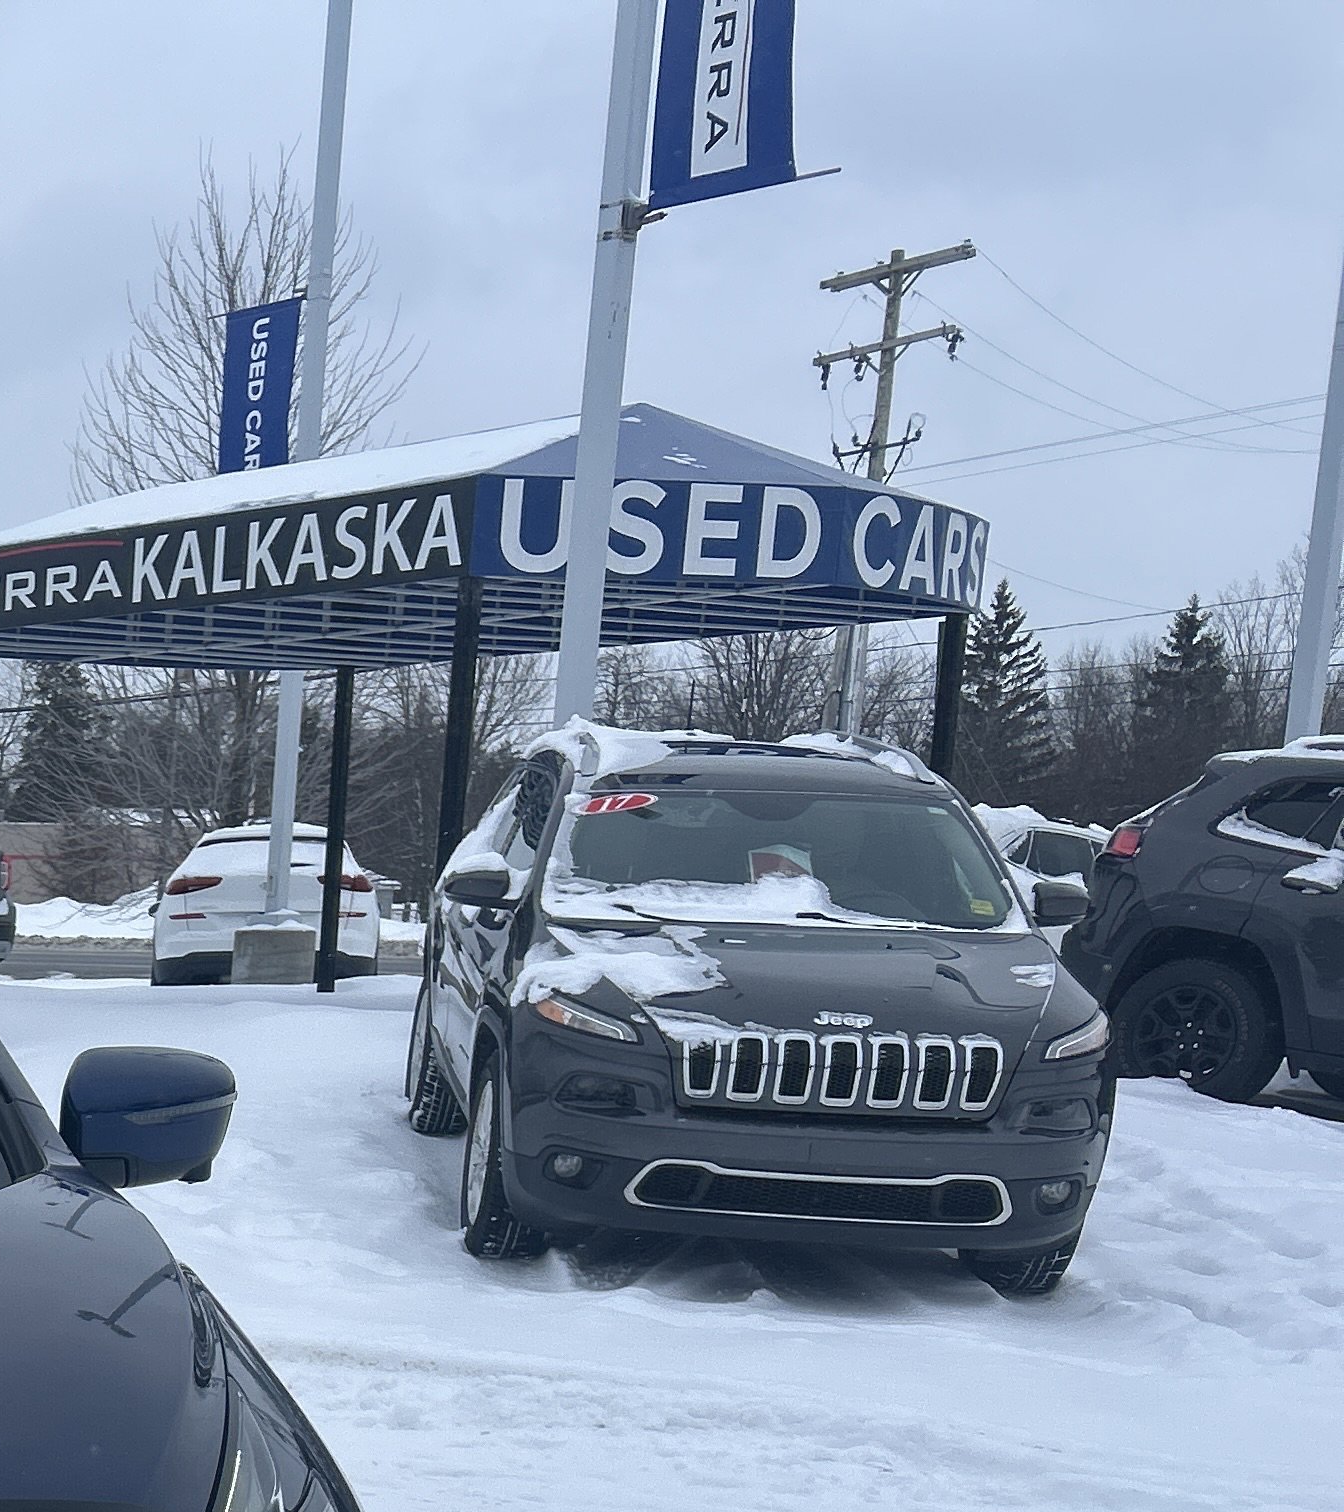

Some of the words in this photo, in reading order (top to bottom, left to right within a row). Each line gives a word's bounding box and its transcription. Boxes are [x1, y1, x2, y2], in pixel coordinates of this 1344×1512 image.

[704, 0, 738, 154] RRA
[247, 317, 271, 401] USED
[131, 493, 463, 603] KALKASKA
[499, 478, 823, 579] USED
[852, 495, 987, 607] CARS
[599, 794, 634, 812] 17
[813, 1010, 874, 1029] Jeep
